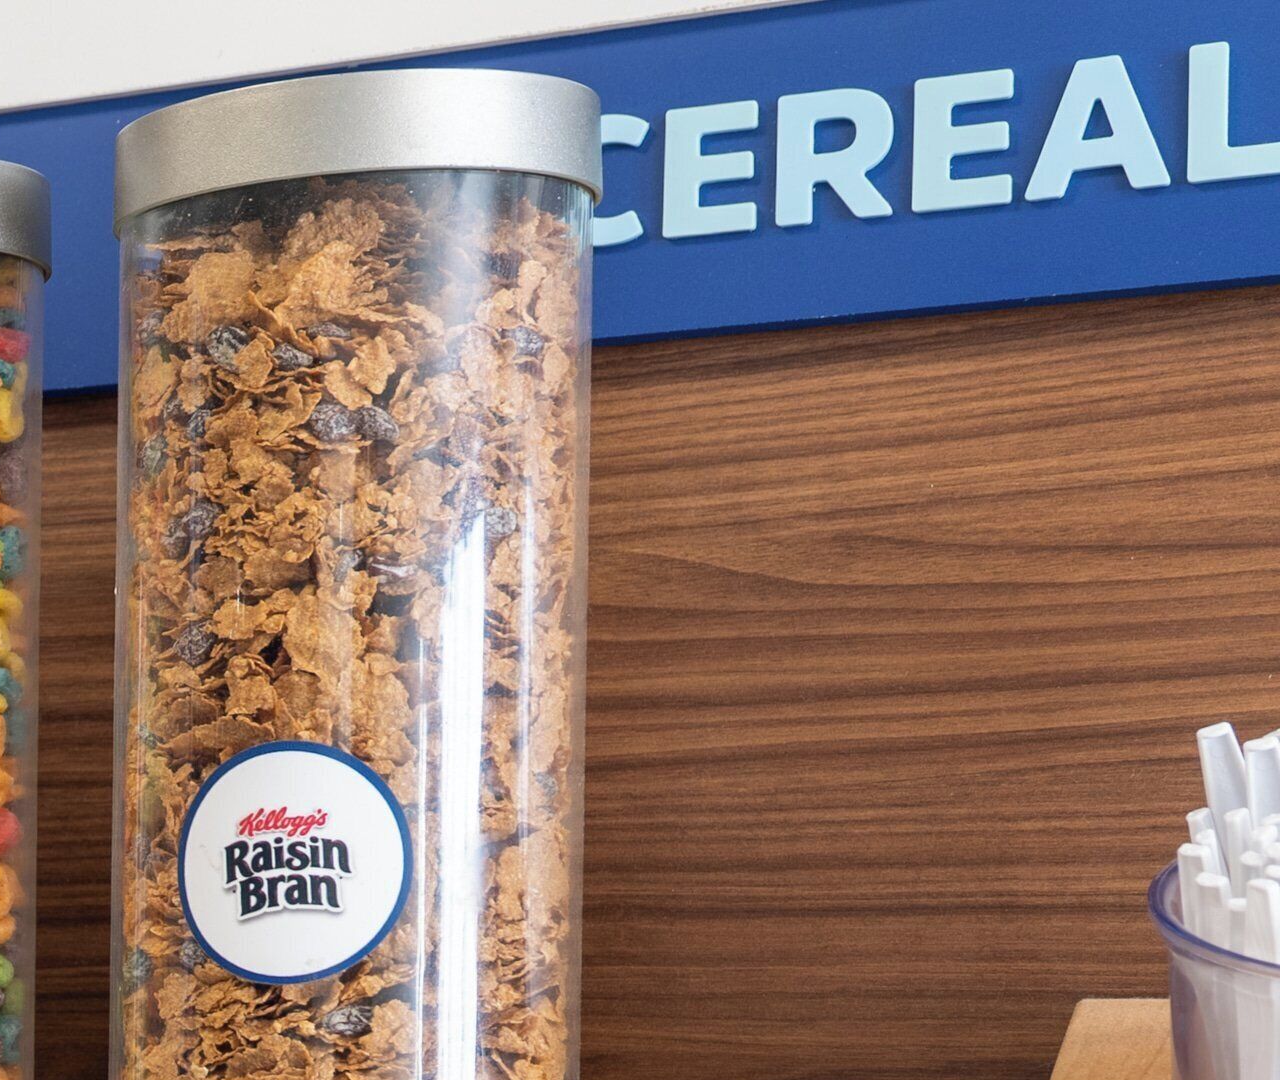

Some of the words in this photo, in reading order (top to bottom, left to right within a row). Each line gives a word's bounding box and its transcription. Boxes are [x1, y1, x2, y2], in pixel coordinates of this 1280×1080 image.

[239, 806, 328, 837] Kellogg's
[224, 836, 352, 884] Raisin
[240, 874, 340, 917] Bran
